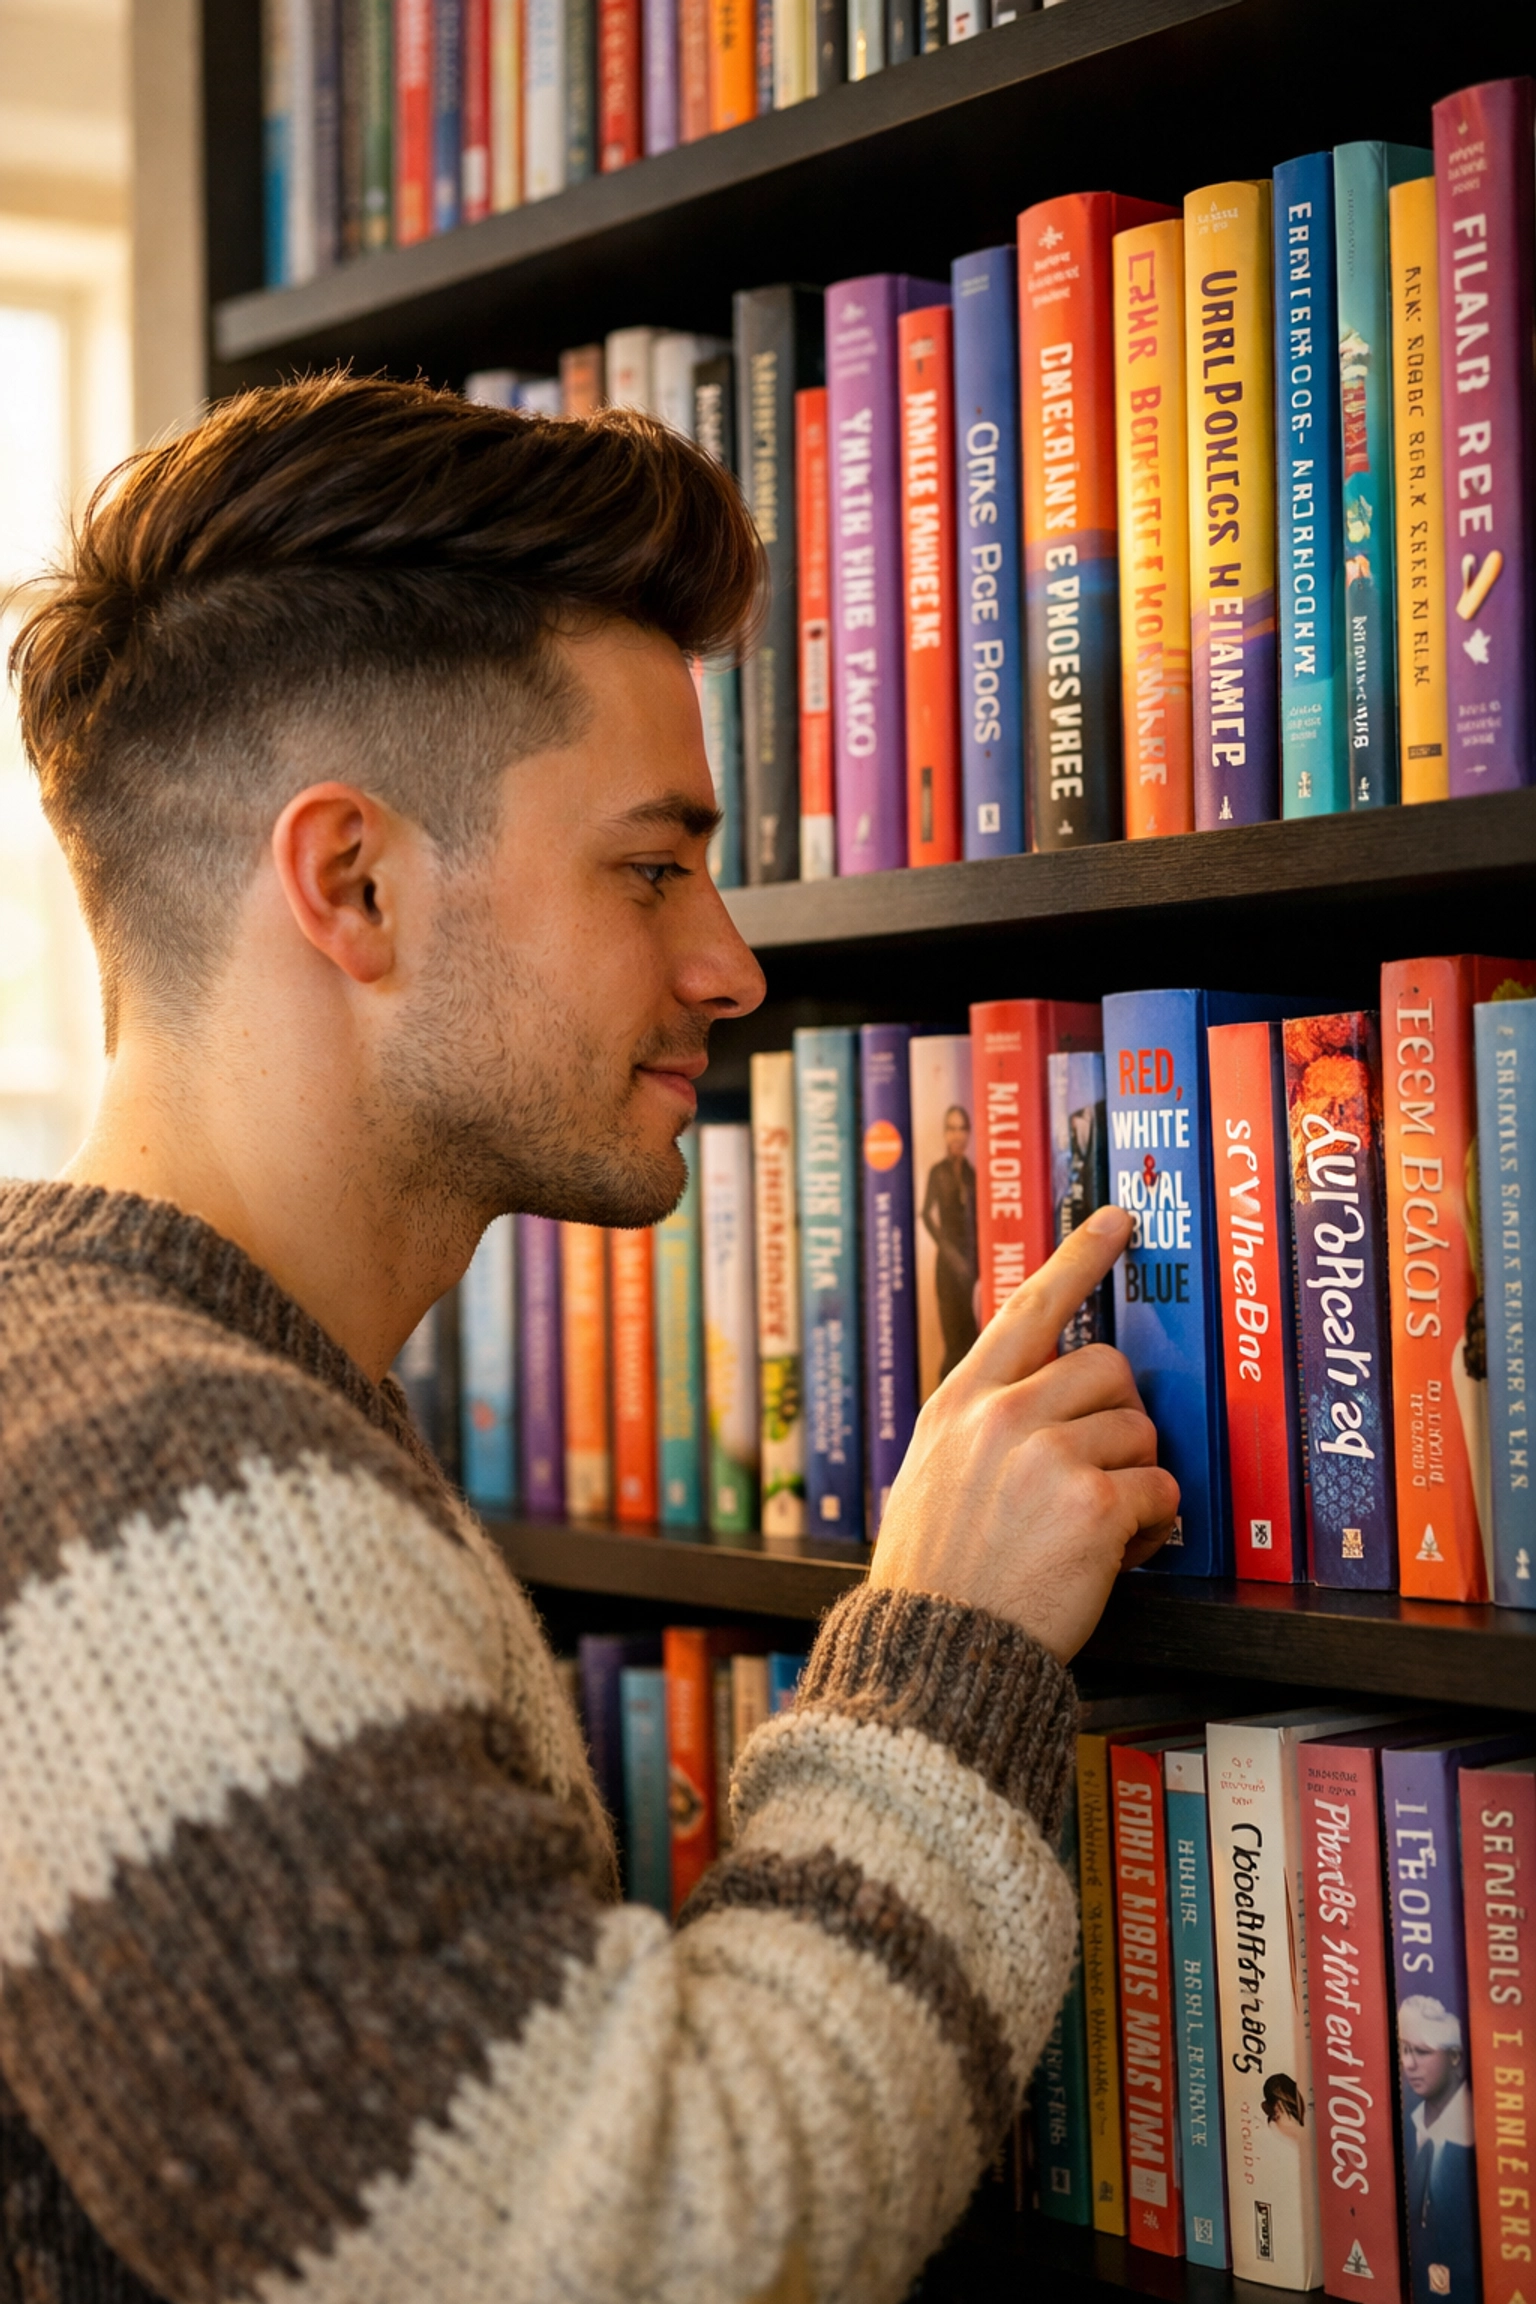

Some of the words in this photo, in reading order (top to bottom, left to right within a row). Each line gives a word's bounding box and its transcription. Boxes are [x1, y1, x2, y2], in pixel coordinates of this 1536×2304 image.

[1118, 1048, 1184, 1102] RED,
[1111, 1108, 1190, 1150] WHITE
[1117, 1170, 1190, 1211] ROYAL
[1128, 1210, 1192, 1250] BLUE
[1125, 1263, 1191, 1304] BLUE
